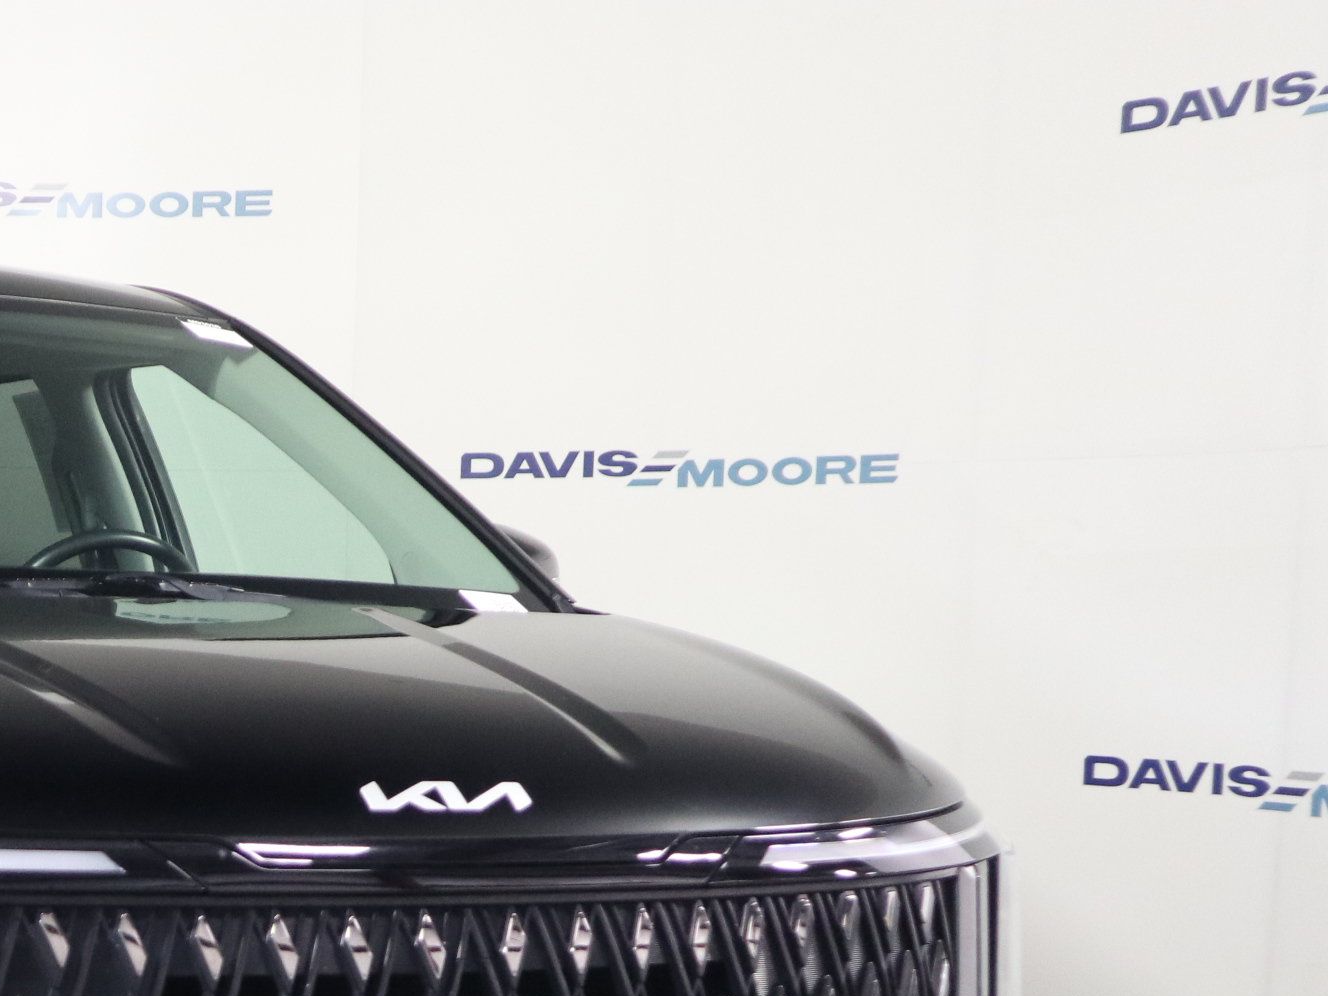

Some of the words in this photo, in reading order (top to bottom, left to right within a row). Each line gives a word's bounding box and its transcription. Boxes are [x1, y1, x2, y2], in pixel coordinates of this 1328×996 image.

[1120, 71, 1317, 134] DAVIS
[57, 190, 273, 218] MOORE
[460, 450, 638, 480] DAVIS
[676, 453, 900, 488] MOORE
[1083, 755, 1271, 798] DAVIS
